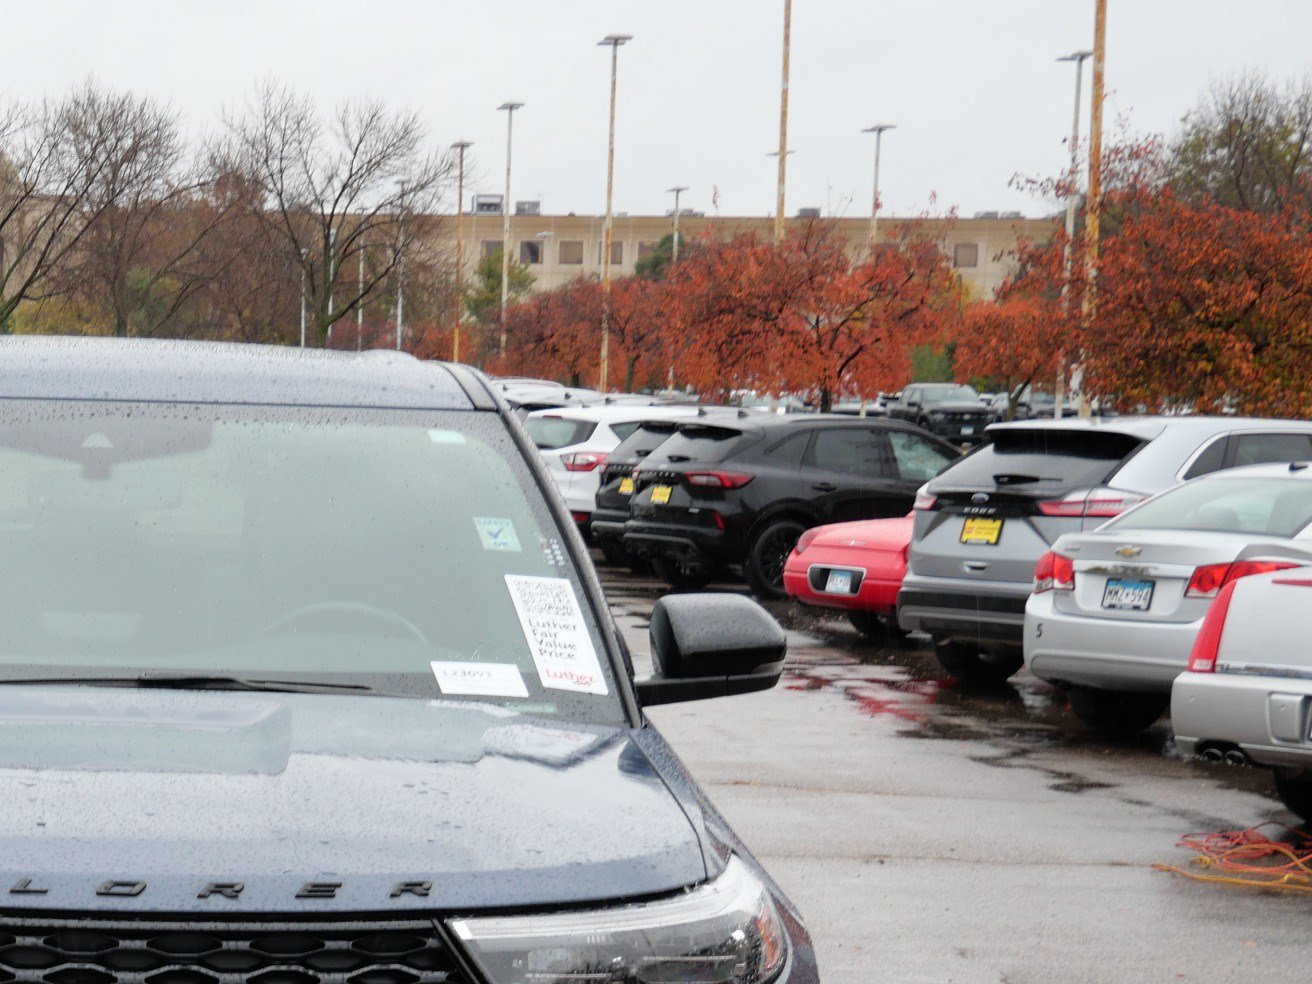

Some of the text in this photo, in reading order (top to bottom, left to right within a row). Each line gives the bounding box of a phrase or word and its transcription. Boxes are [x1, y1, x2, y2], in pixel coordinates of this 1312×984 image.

[529, 618, 577, 631] Luther
[532, 629, 558, 638] Fair
[546, 668, 596, 684] Luther
